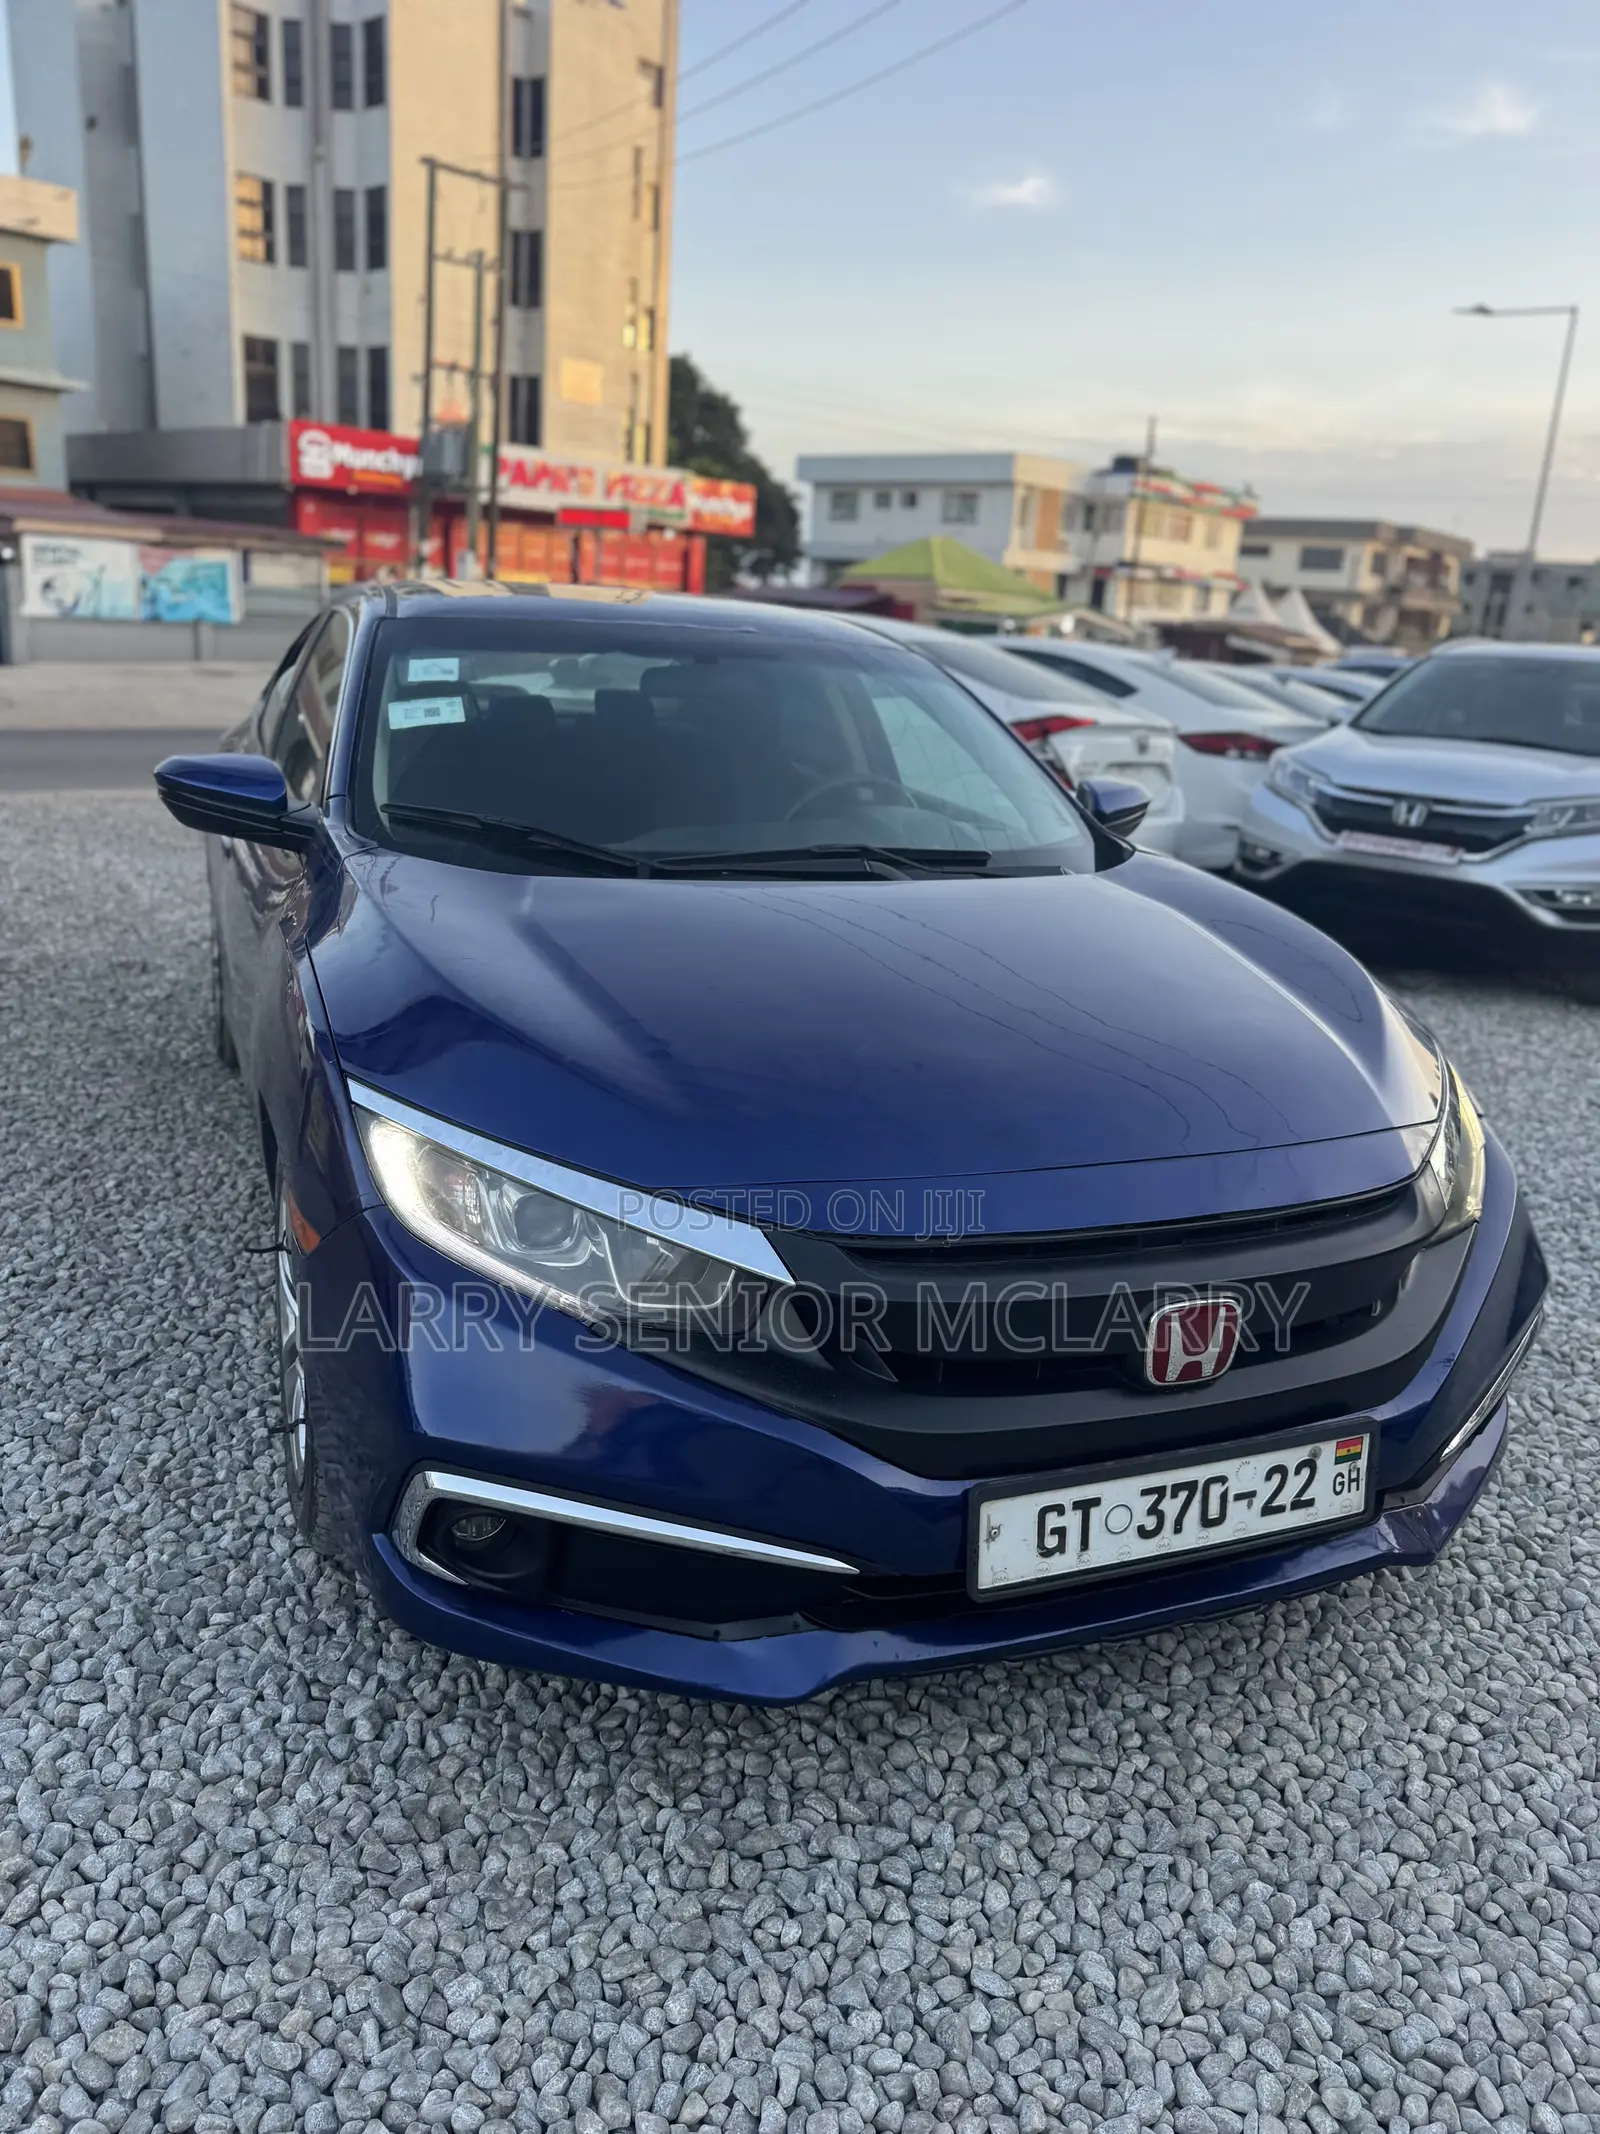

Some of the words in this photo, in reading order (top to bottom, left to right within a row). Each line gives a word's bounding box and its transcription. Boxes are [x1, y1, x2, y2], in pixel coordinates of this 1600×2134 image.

[605, 469, 686, 508] PIZZA
[1332, 1466, 1361, 1496] GH
[1037, 1497, 1102, 1557] GT
[1136, 1458, 1317, 1540] 370-22
